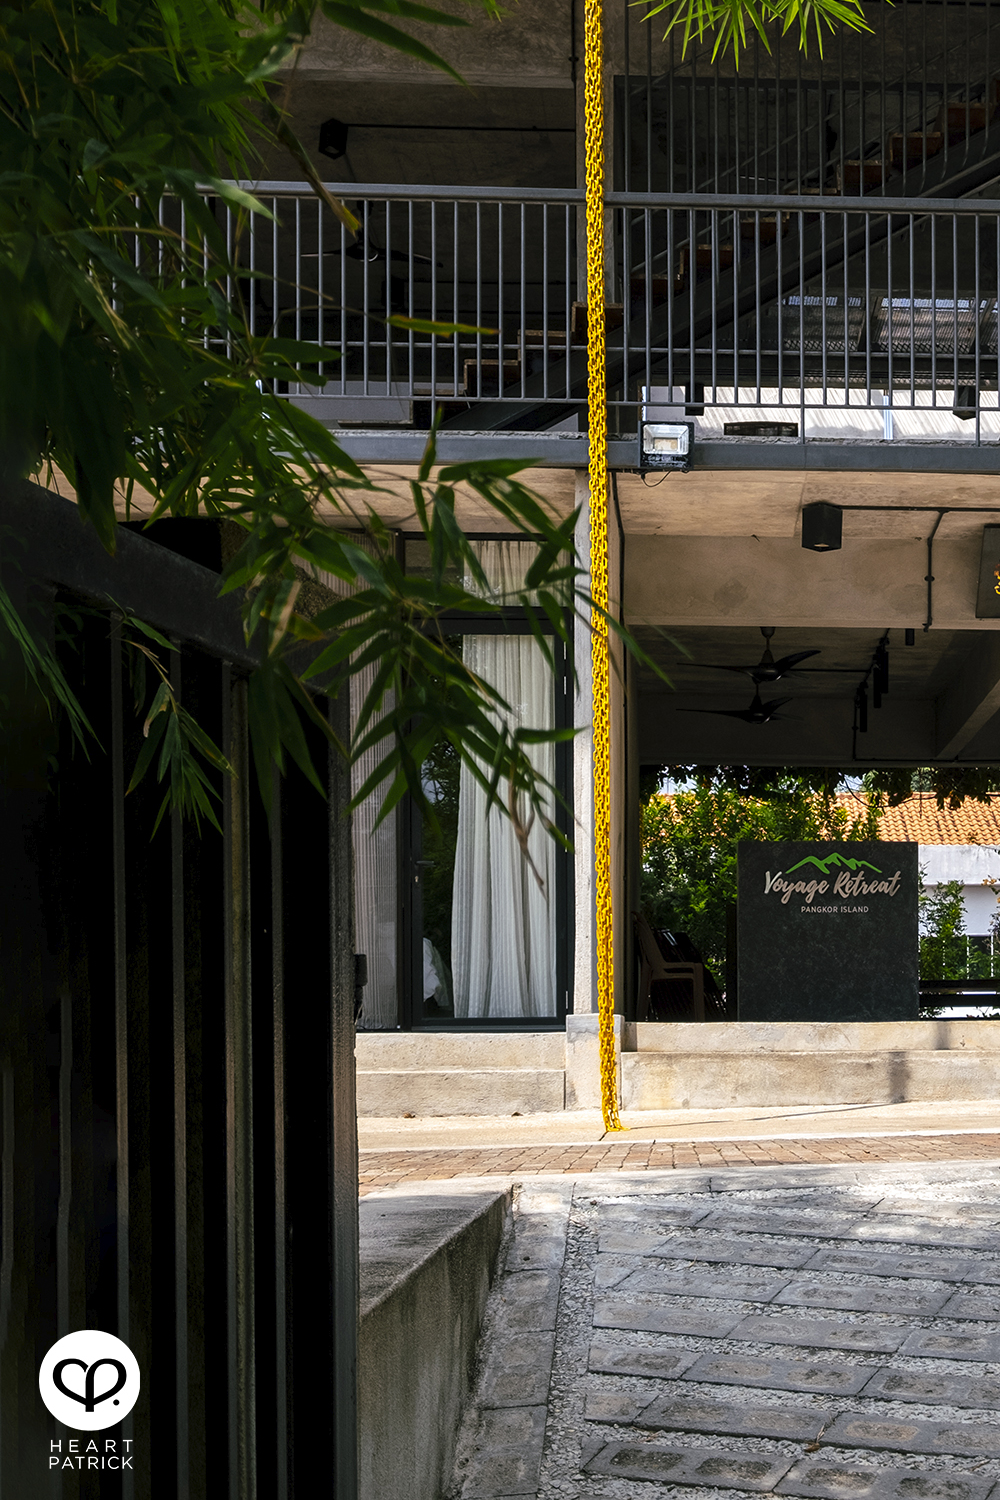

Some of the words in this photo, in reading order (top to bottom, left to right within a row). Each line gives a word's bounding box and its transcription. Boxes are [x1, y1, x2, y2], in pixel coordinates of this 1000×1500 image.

[764, 871, 830, 904] Voyage
[833, 870, 902, 899] Retreat
[801, 905, 838, 913] PANGKOR
[840, 905, 869, 913] ISLAND
